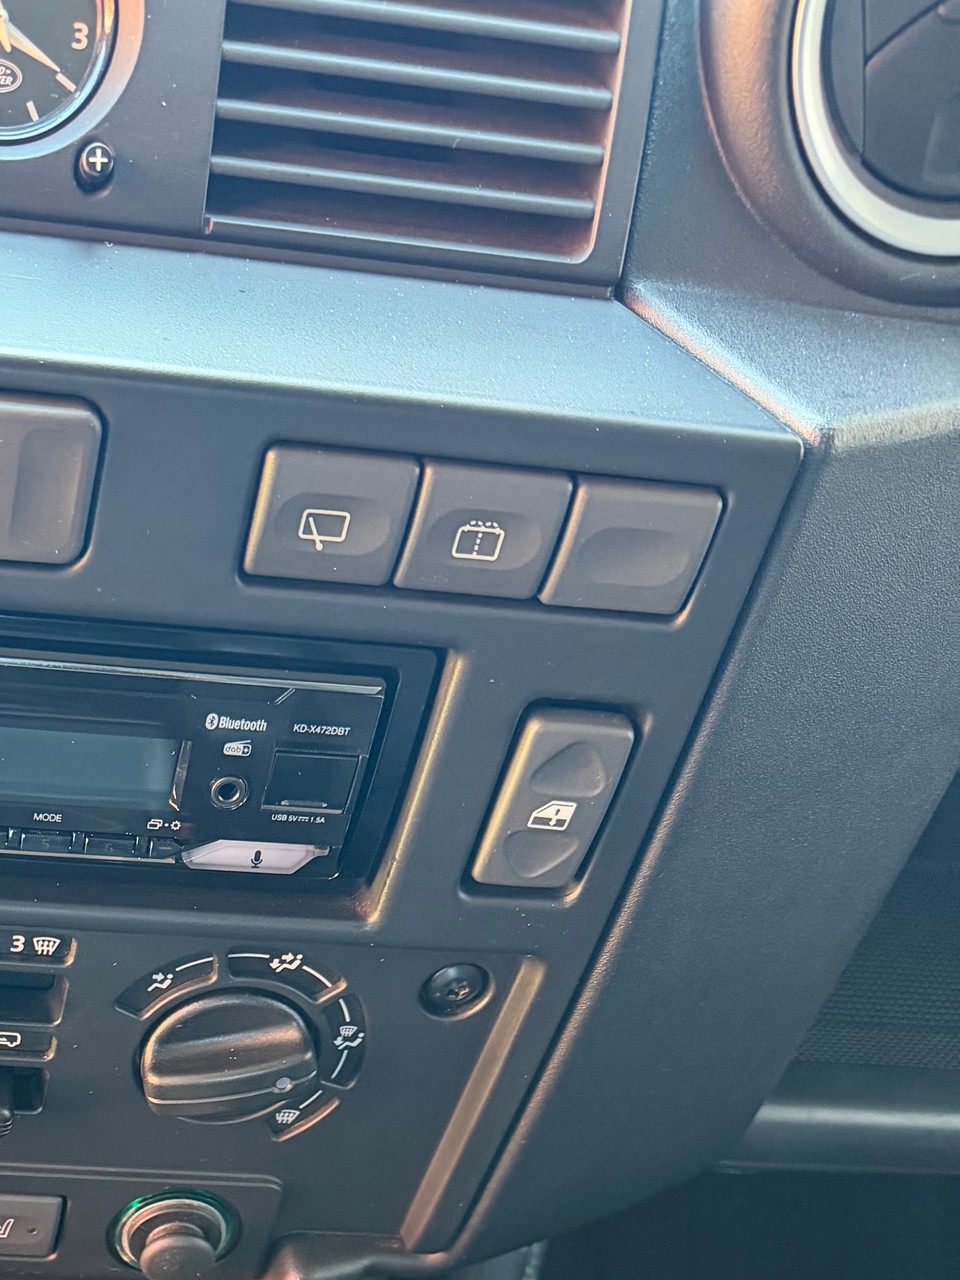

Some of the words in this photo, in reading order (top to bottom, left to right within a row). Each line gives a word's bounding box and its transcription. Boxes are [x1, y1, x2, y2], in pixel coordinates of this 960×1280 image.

[71, 22, 89, 50] 3
[218, 715, 268, 732] Bluetooth
[292, 723, 351, 737] KD-X472DBT
[33, 812, 63, 823] MODE
[271, 813, 288, 822] USB
[310, 815, 326, 824] 1.5A
[9, 935, 26, 953] 3
